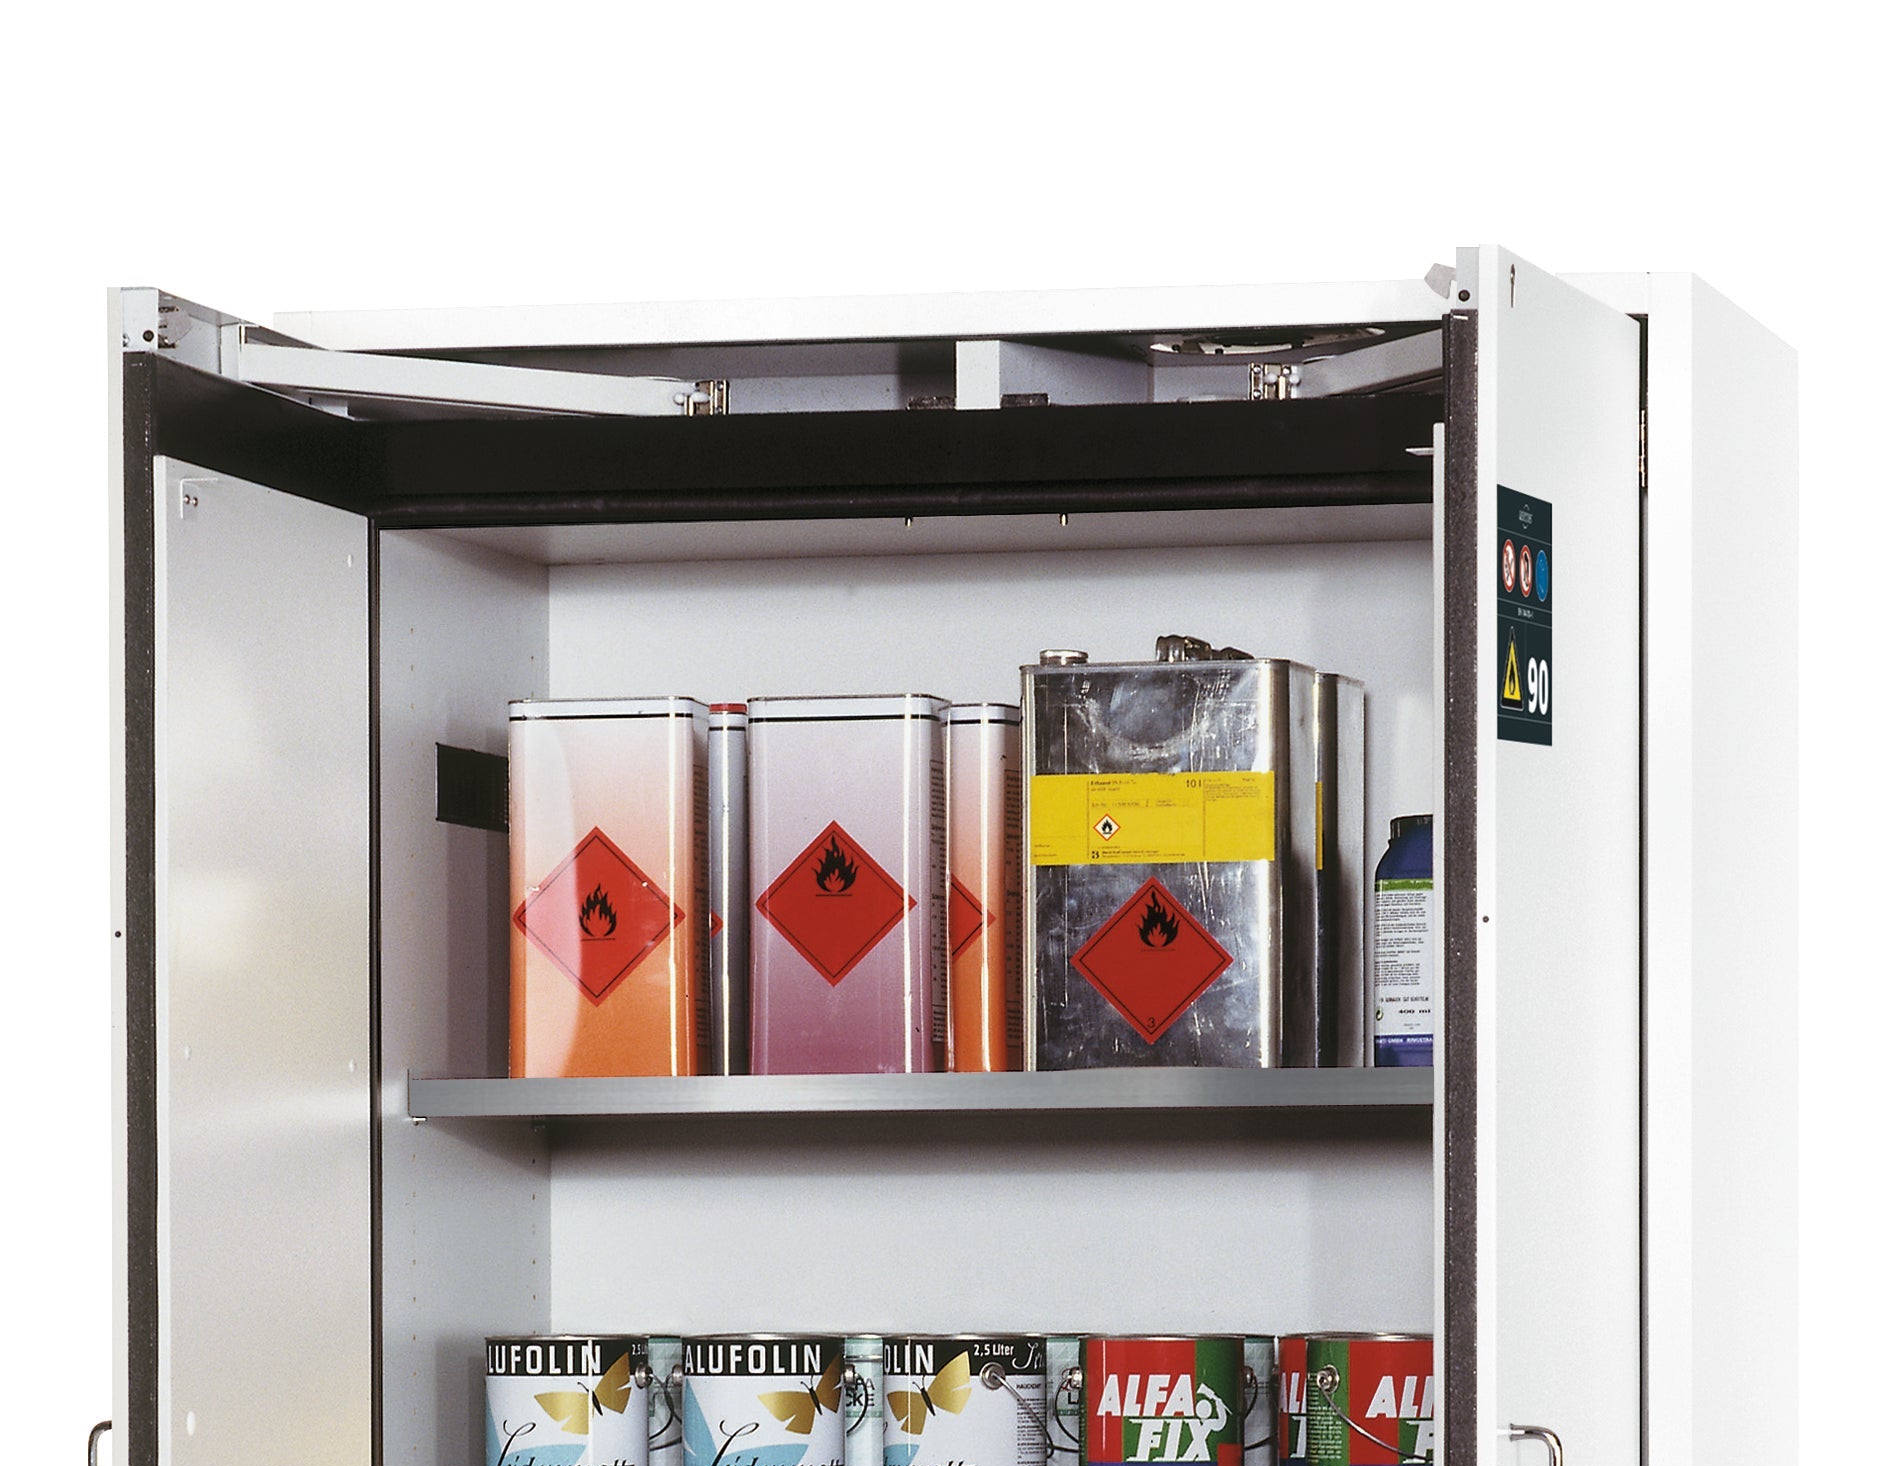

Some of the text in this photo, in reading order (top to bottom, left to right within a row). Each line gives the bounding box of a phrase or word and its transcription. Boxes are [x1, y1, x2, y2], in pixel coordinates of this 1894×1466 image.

[1527, 656, 1549, 716] 90
[1147, 1016, 1156, 1029] 3
[488, 1343, 600, 1375] LUFOLIN
[684, 1343, 822, 1375] ALUFOLIN
[973, 1343, 1015, 1357] 2,5 Liter
[1096, 1373, 1196, 1417] ALFA
[1125, 1417, 1216, 1463] FIX
